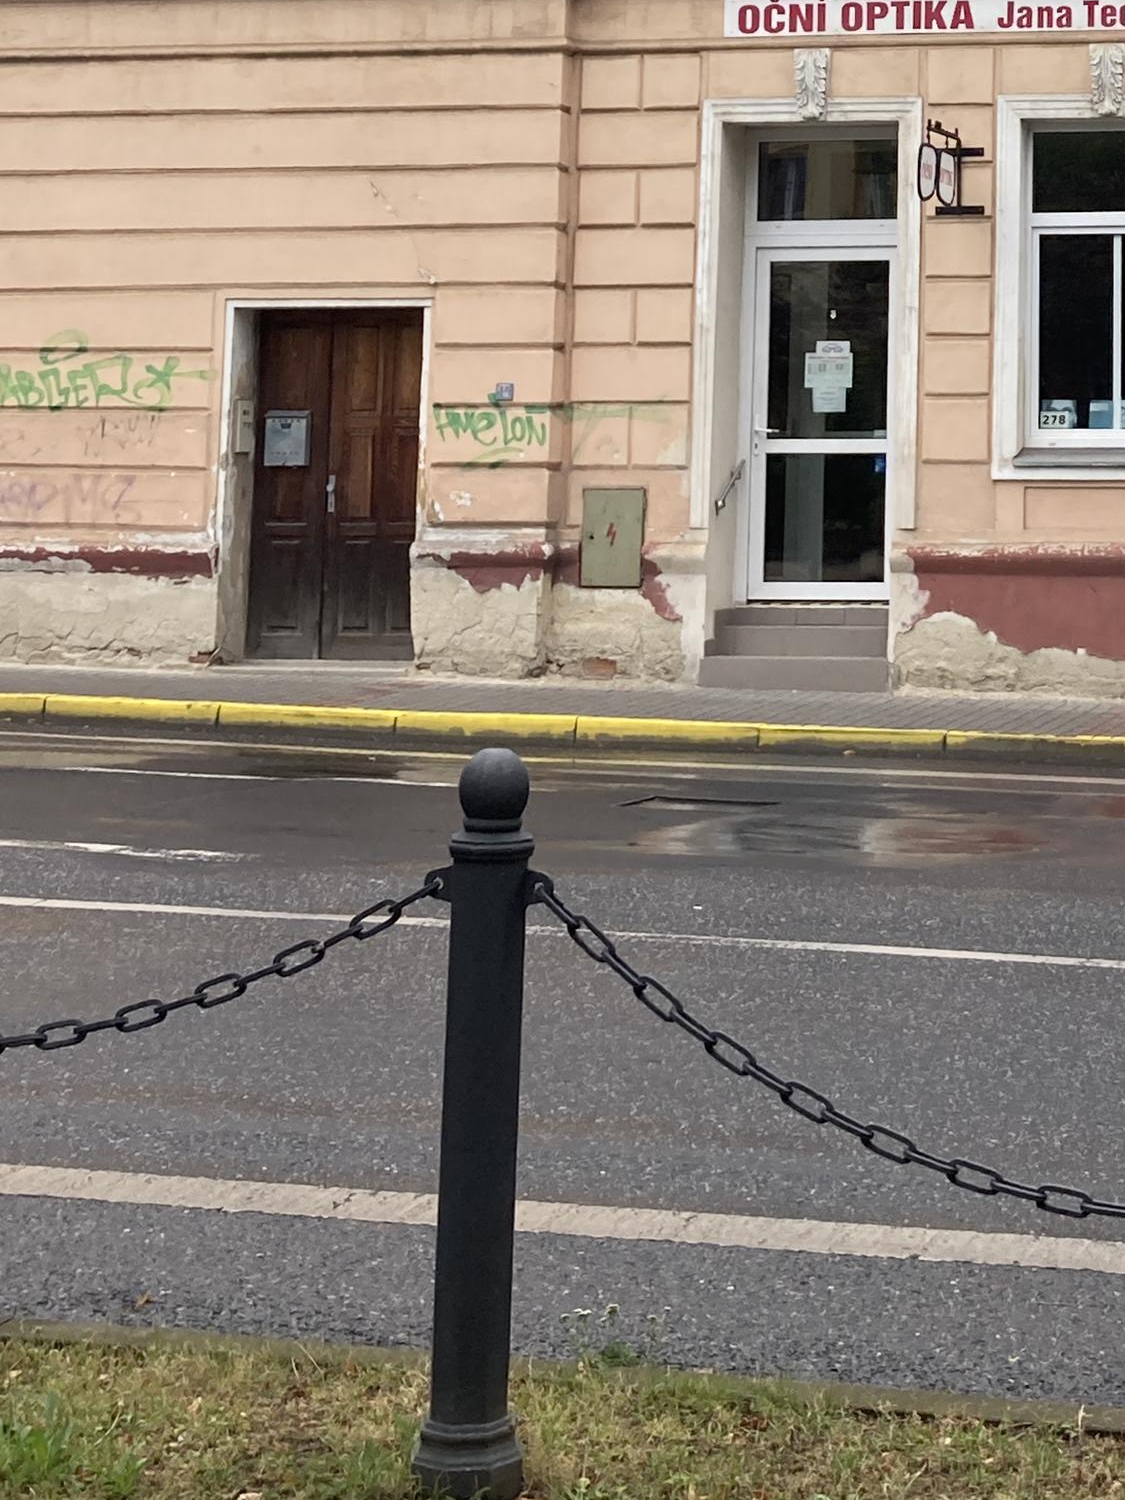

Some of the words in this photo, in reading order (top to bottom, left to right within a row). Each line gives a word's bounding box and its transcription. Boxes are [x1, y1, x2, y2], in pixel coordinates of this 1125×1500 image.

[841, 0, 975, 32] OPTIKA
[997, 0, 1073, 29] Jana
[1042, 414, 1066, 425] 278
